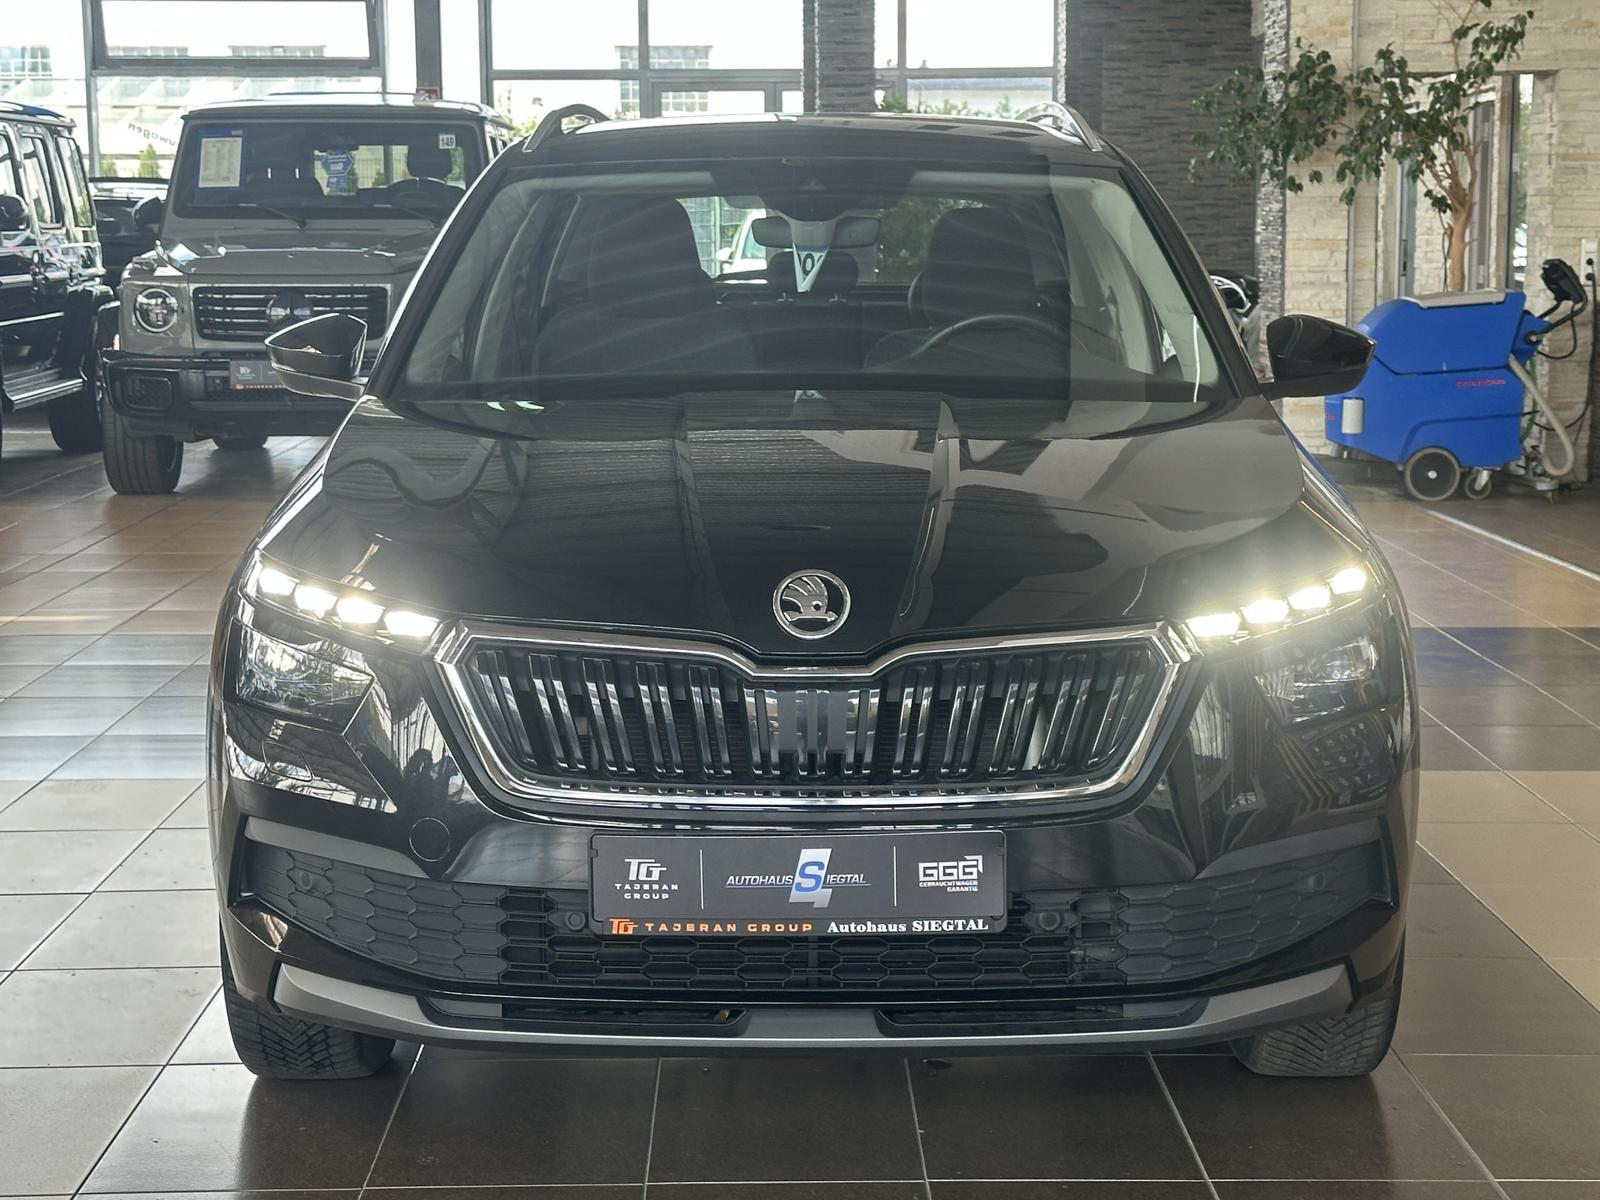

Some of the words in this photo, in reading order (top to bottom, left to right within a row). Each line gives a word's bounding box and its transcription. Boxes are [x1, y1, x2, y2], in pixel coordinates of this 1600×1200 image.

[918, 860, 979, 881] GGG
[726, 875, 794, 886] AUTOHAUS
[645, 923, 737, 932] TAJERAN
[747, 922, 812, 932] GROUP
[827, 920, 907, 933] Autohaus
[911, 918, 989, 932] SIEGTAL
